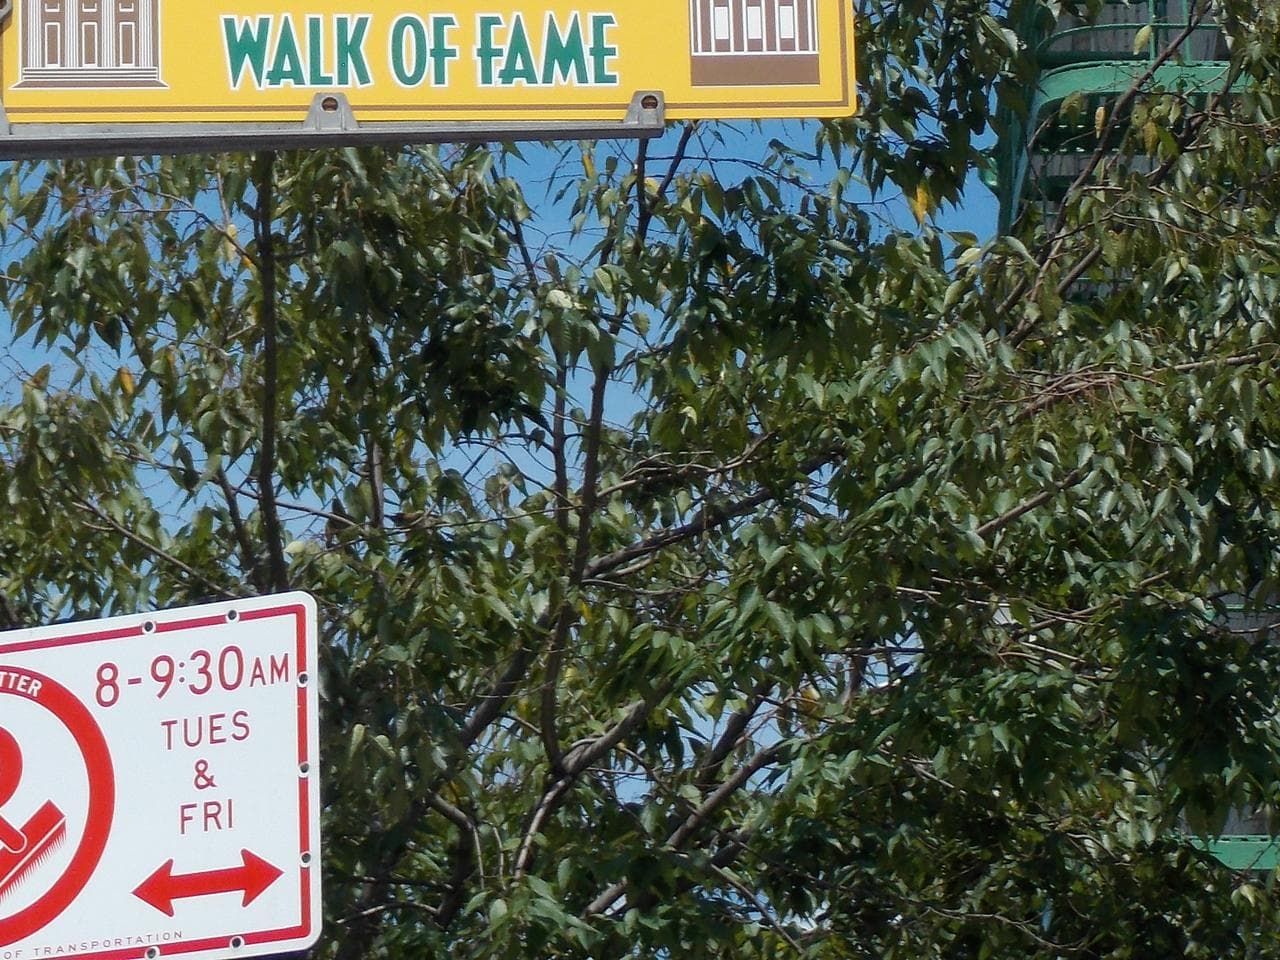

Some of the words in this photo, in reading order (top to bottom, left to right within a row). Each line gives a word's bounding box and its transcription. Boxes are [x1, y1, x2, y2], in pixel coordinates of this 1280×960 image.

[219, 12, 373, 89] WALK
[389, 13, 461, 88] OF
[475, 10, 620, 88] FAME
[94, 645, 290, 708] 8-9:30AM
[161, 710, 251, 751] TUES
[193, 759, 217, 790] &
[179, 797, 235, 836] FRI
[3, 950, 22, 959] OF
[33, 930, 184, 956] TRANSPORTATION
